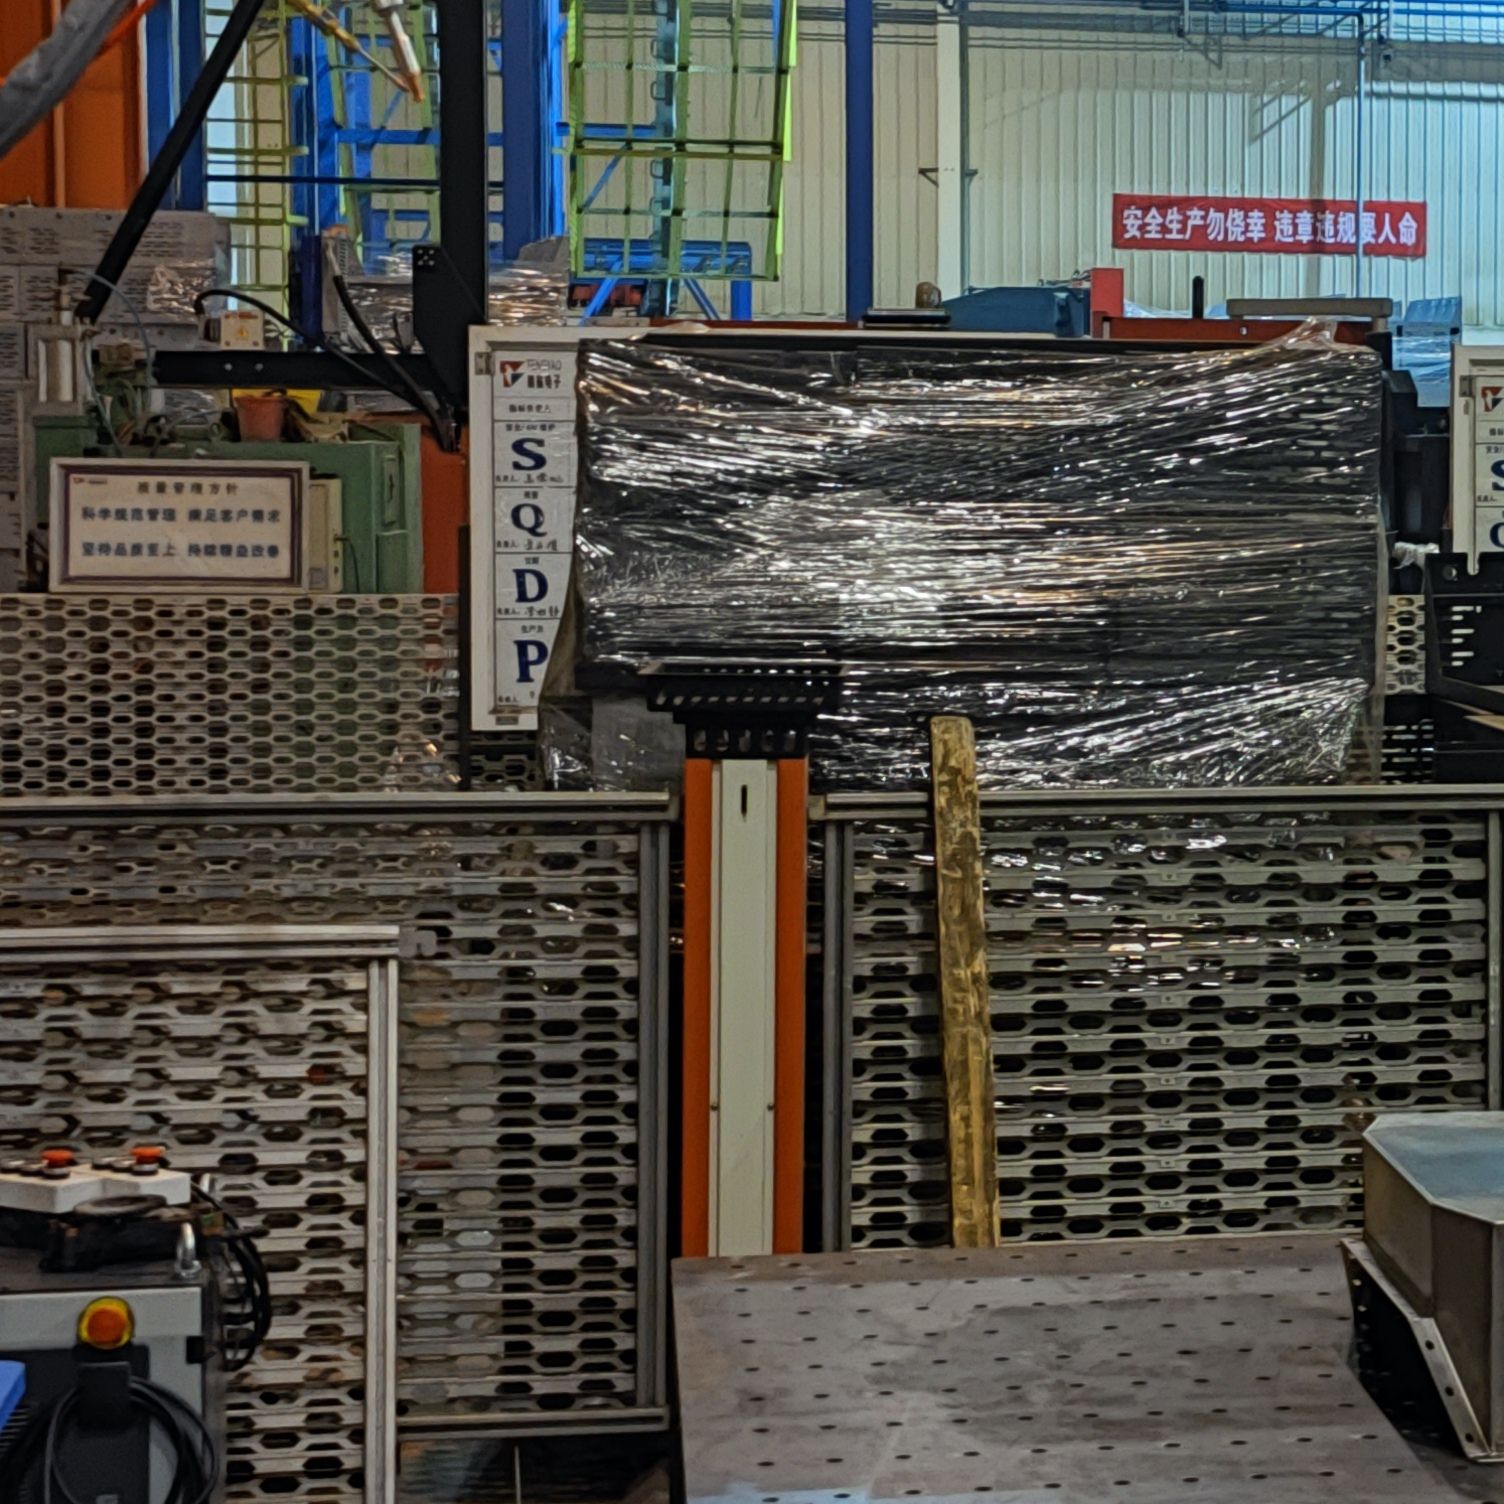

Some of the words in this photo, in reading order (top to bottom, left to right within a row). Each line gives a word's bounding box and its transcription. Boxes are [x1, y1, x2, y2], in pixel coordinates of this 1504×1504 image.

[1122, 205, 1266, 243] 安全生产勿侥幸
[1274, 210, 1418, 246] 违章违规要人命
[511, 437, 548, 471] S
[511, 503, 548, 537] Q
[512, 568, 549, 604] D
[513, 639, 549, 684] P
